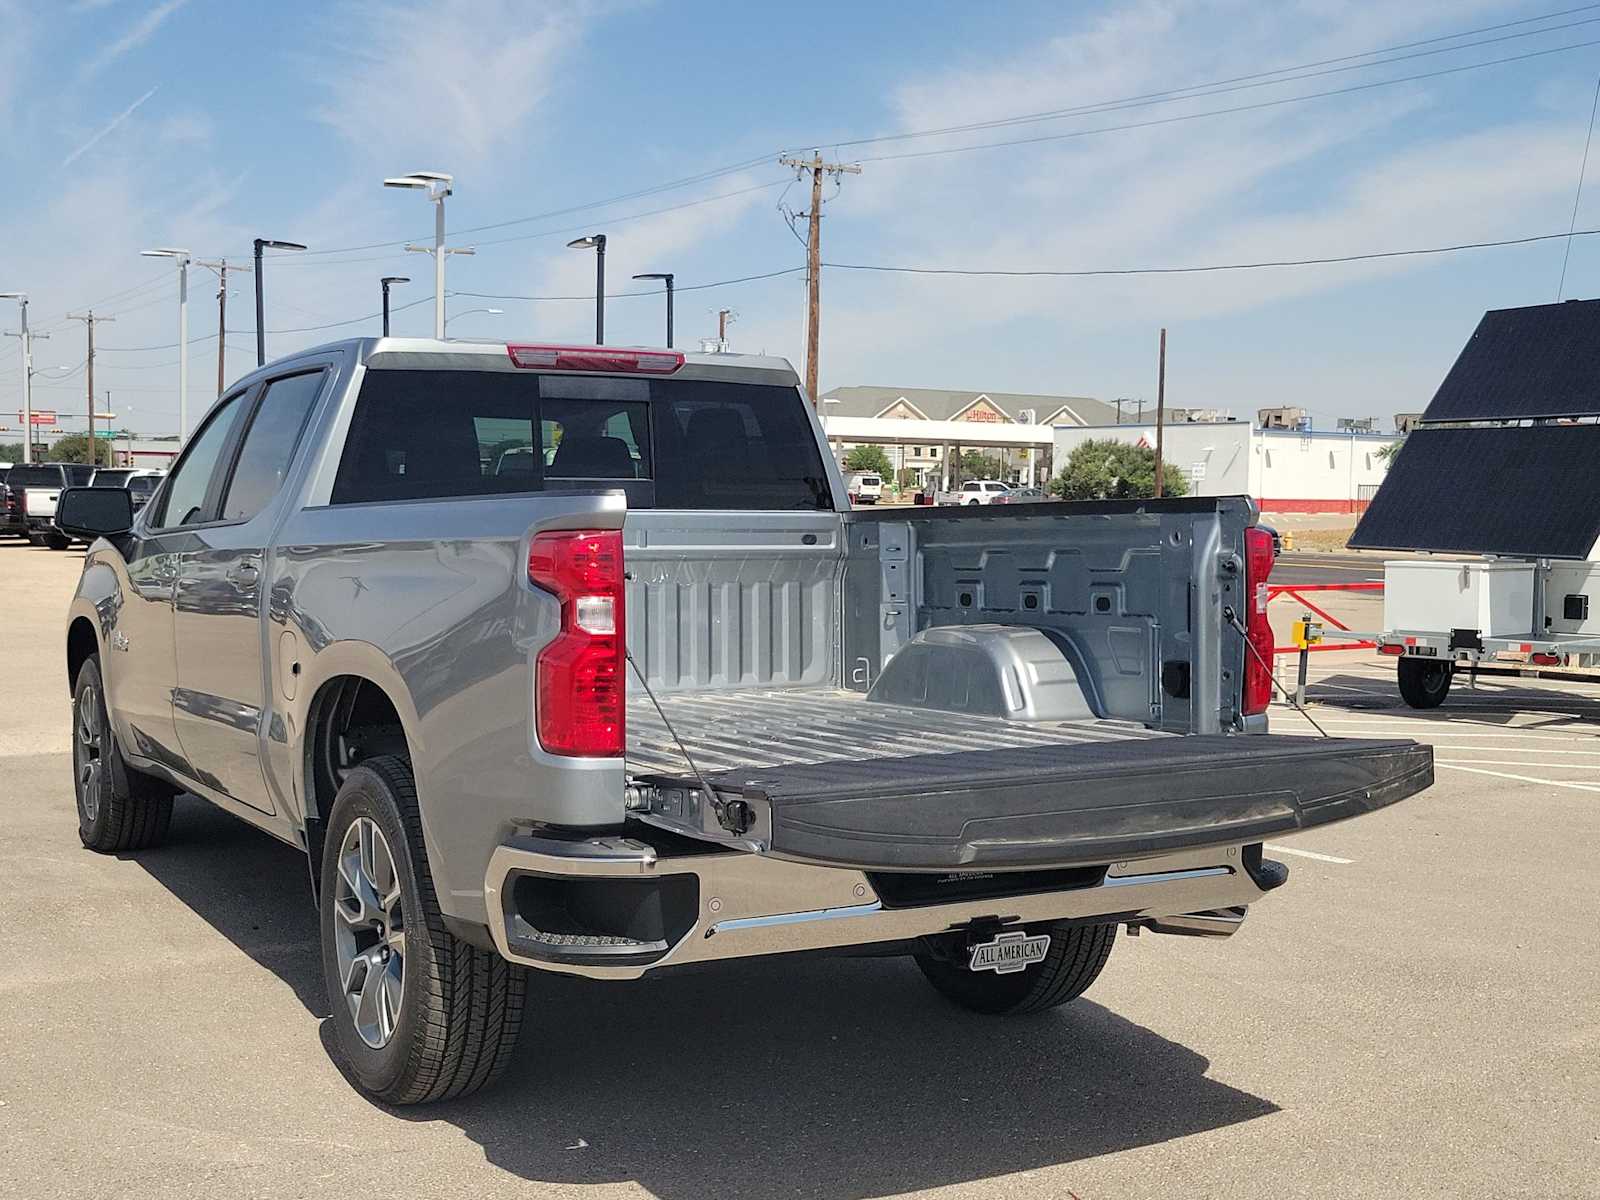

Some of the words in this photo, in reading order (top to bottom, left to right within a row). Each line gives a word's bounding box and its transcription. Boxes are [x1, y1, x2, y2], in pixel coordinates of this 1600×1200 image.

[972, 410, 997, 420] Hilton
[979, 948, 995, 963] ALL
[997, 942, 1042, 961] AMERICAN
